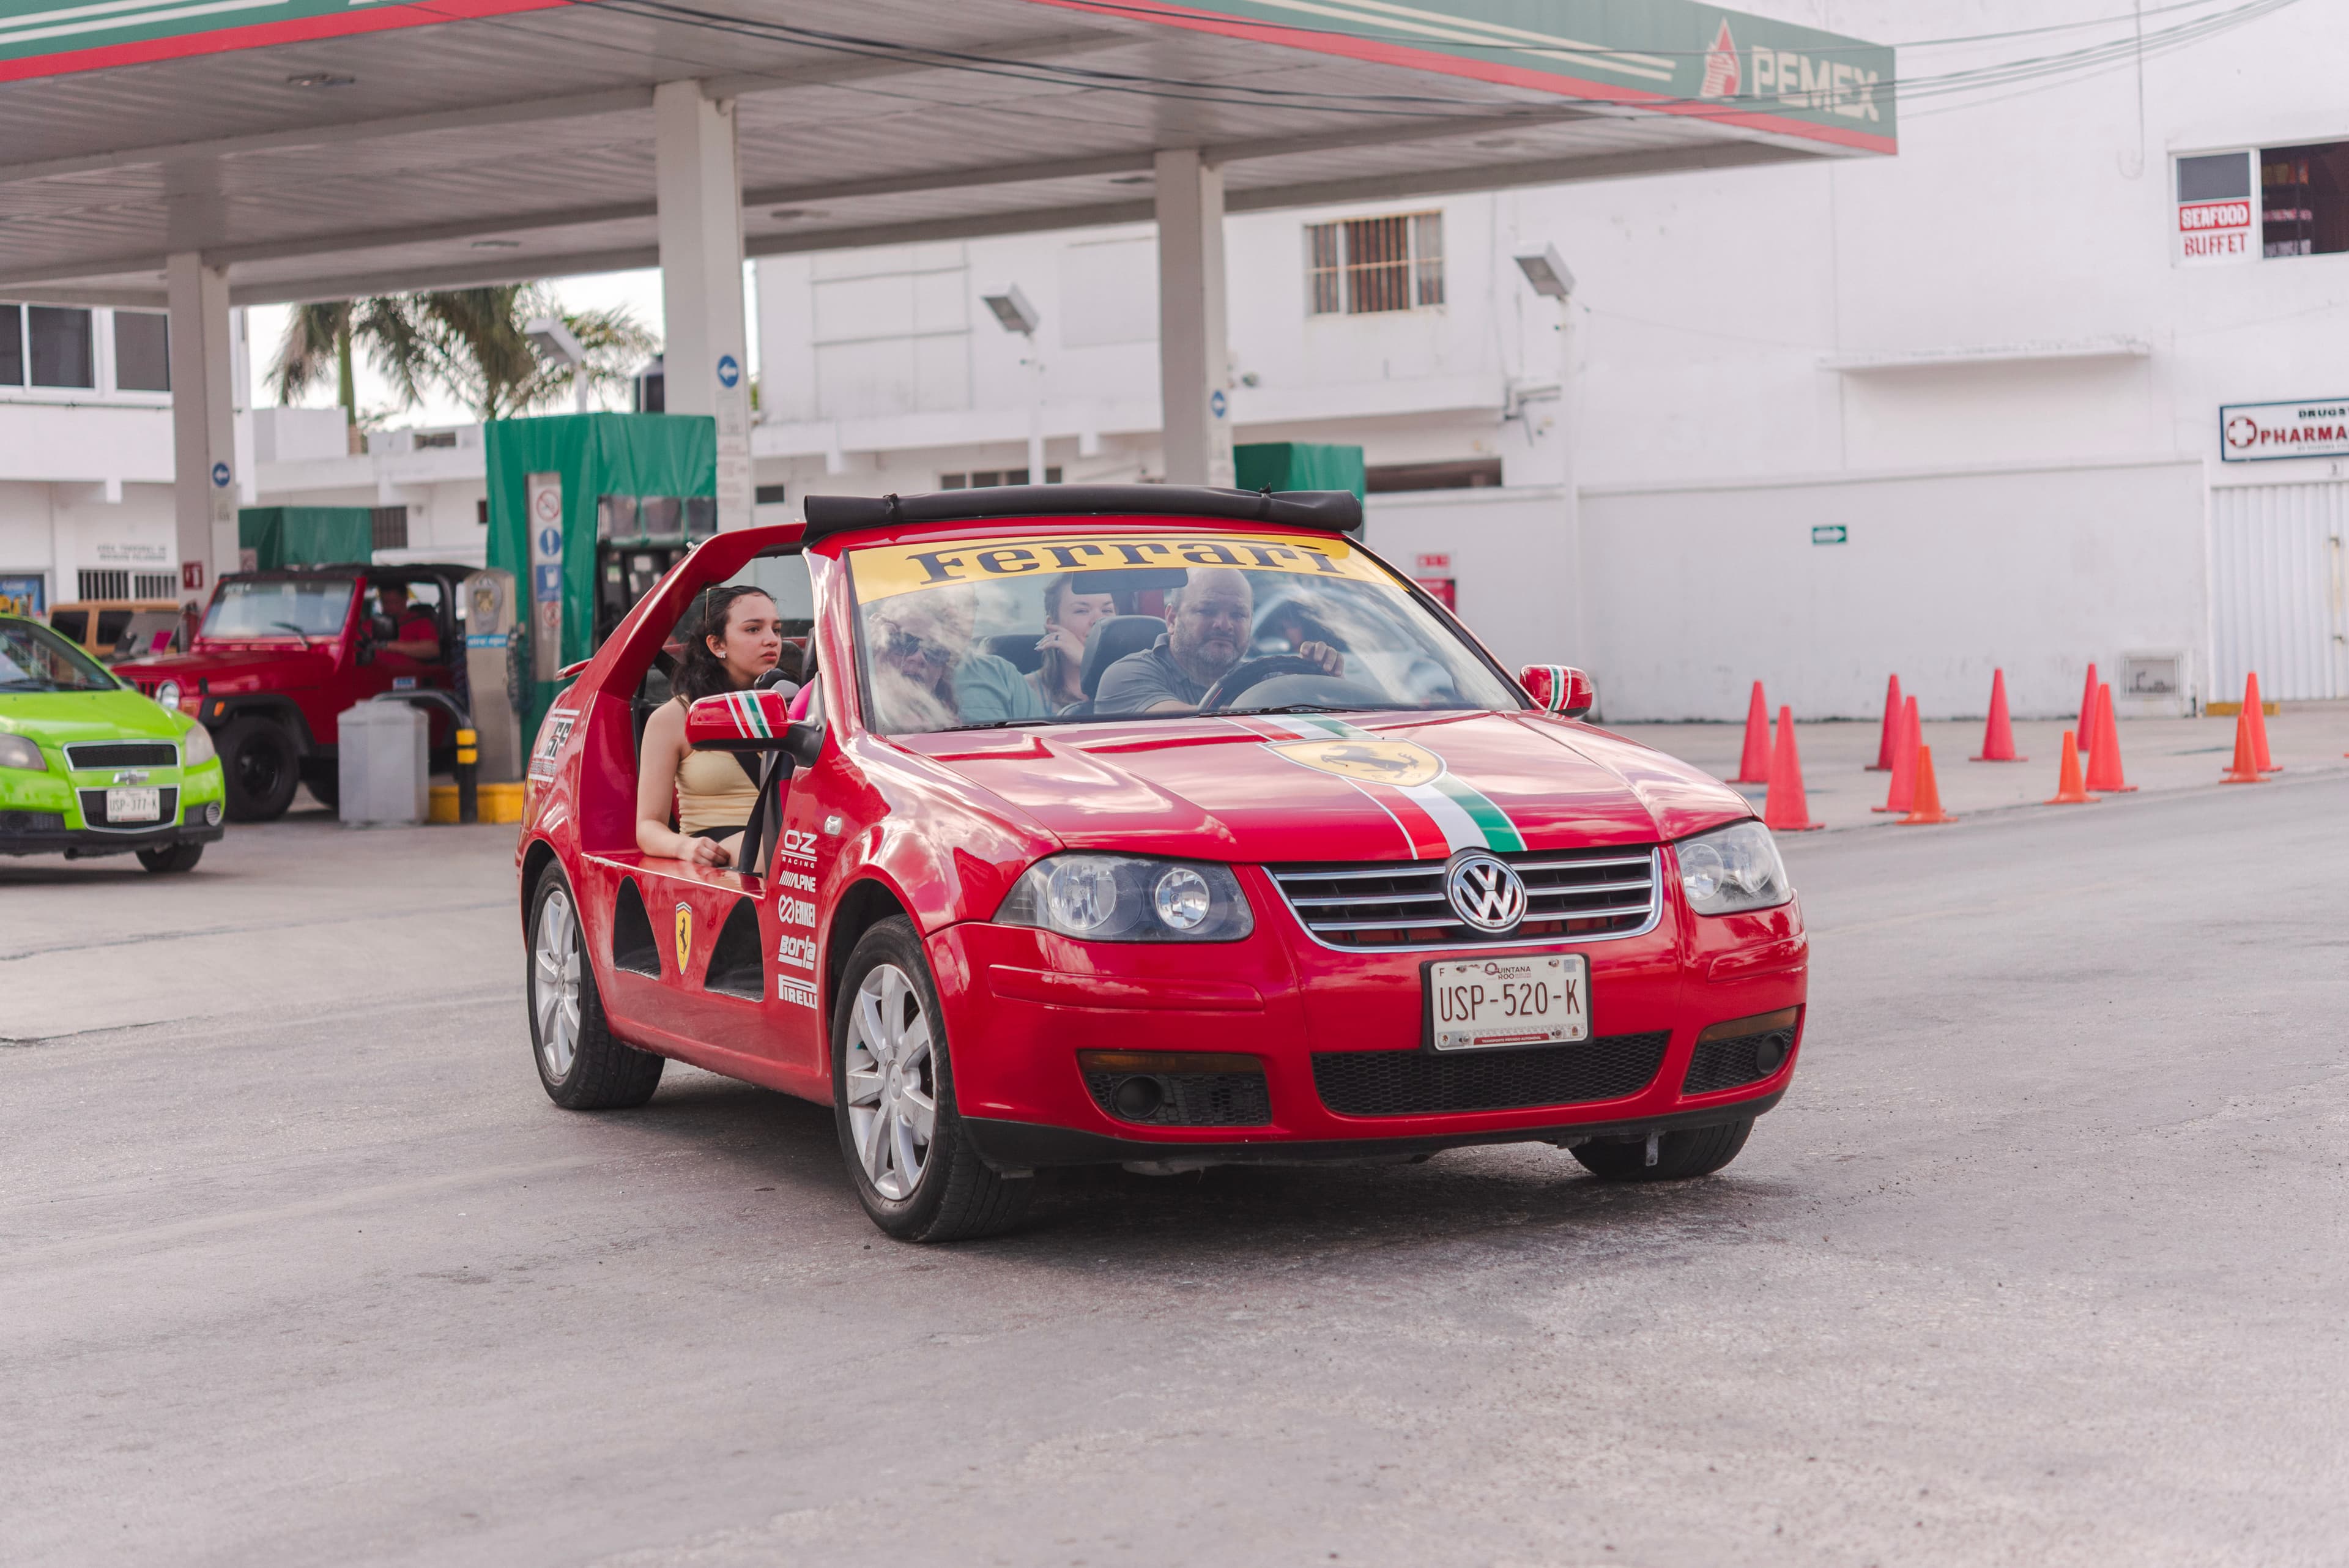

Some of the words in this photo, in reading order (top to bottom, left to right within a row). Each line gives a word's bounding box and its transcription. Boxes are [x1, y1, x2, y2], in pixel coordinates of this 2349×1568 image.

[1752, 45, 1880, 122] PEMEX
[2181, 204, 2248, 229] SEAFOOD
[2184, 232, 2247, 256] BUFFET
[2298, 408, 2349, 418] DRUGS
[2260, 426, 2349, 444] PHARMA
[907, 538, 1346, 585] Ferrari
[782, 856, 815, 869] RACING
[779, 871, 817, 893] ALPINE
[1439, 968, 1445, 977] F
[1485, 962, 1531, 976] QUINTANA
[777, 973, 818, 1010] PIRELLI
[1440, 979, 1580, 1022] USP-520-K
